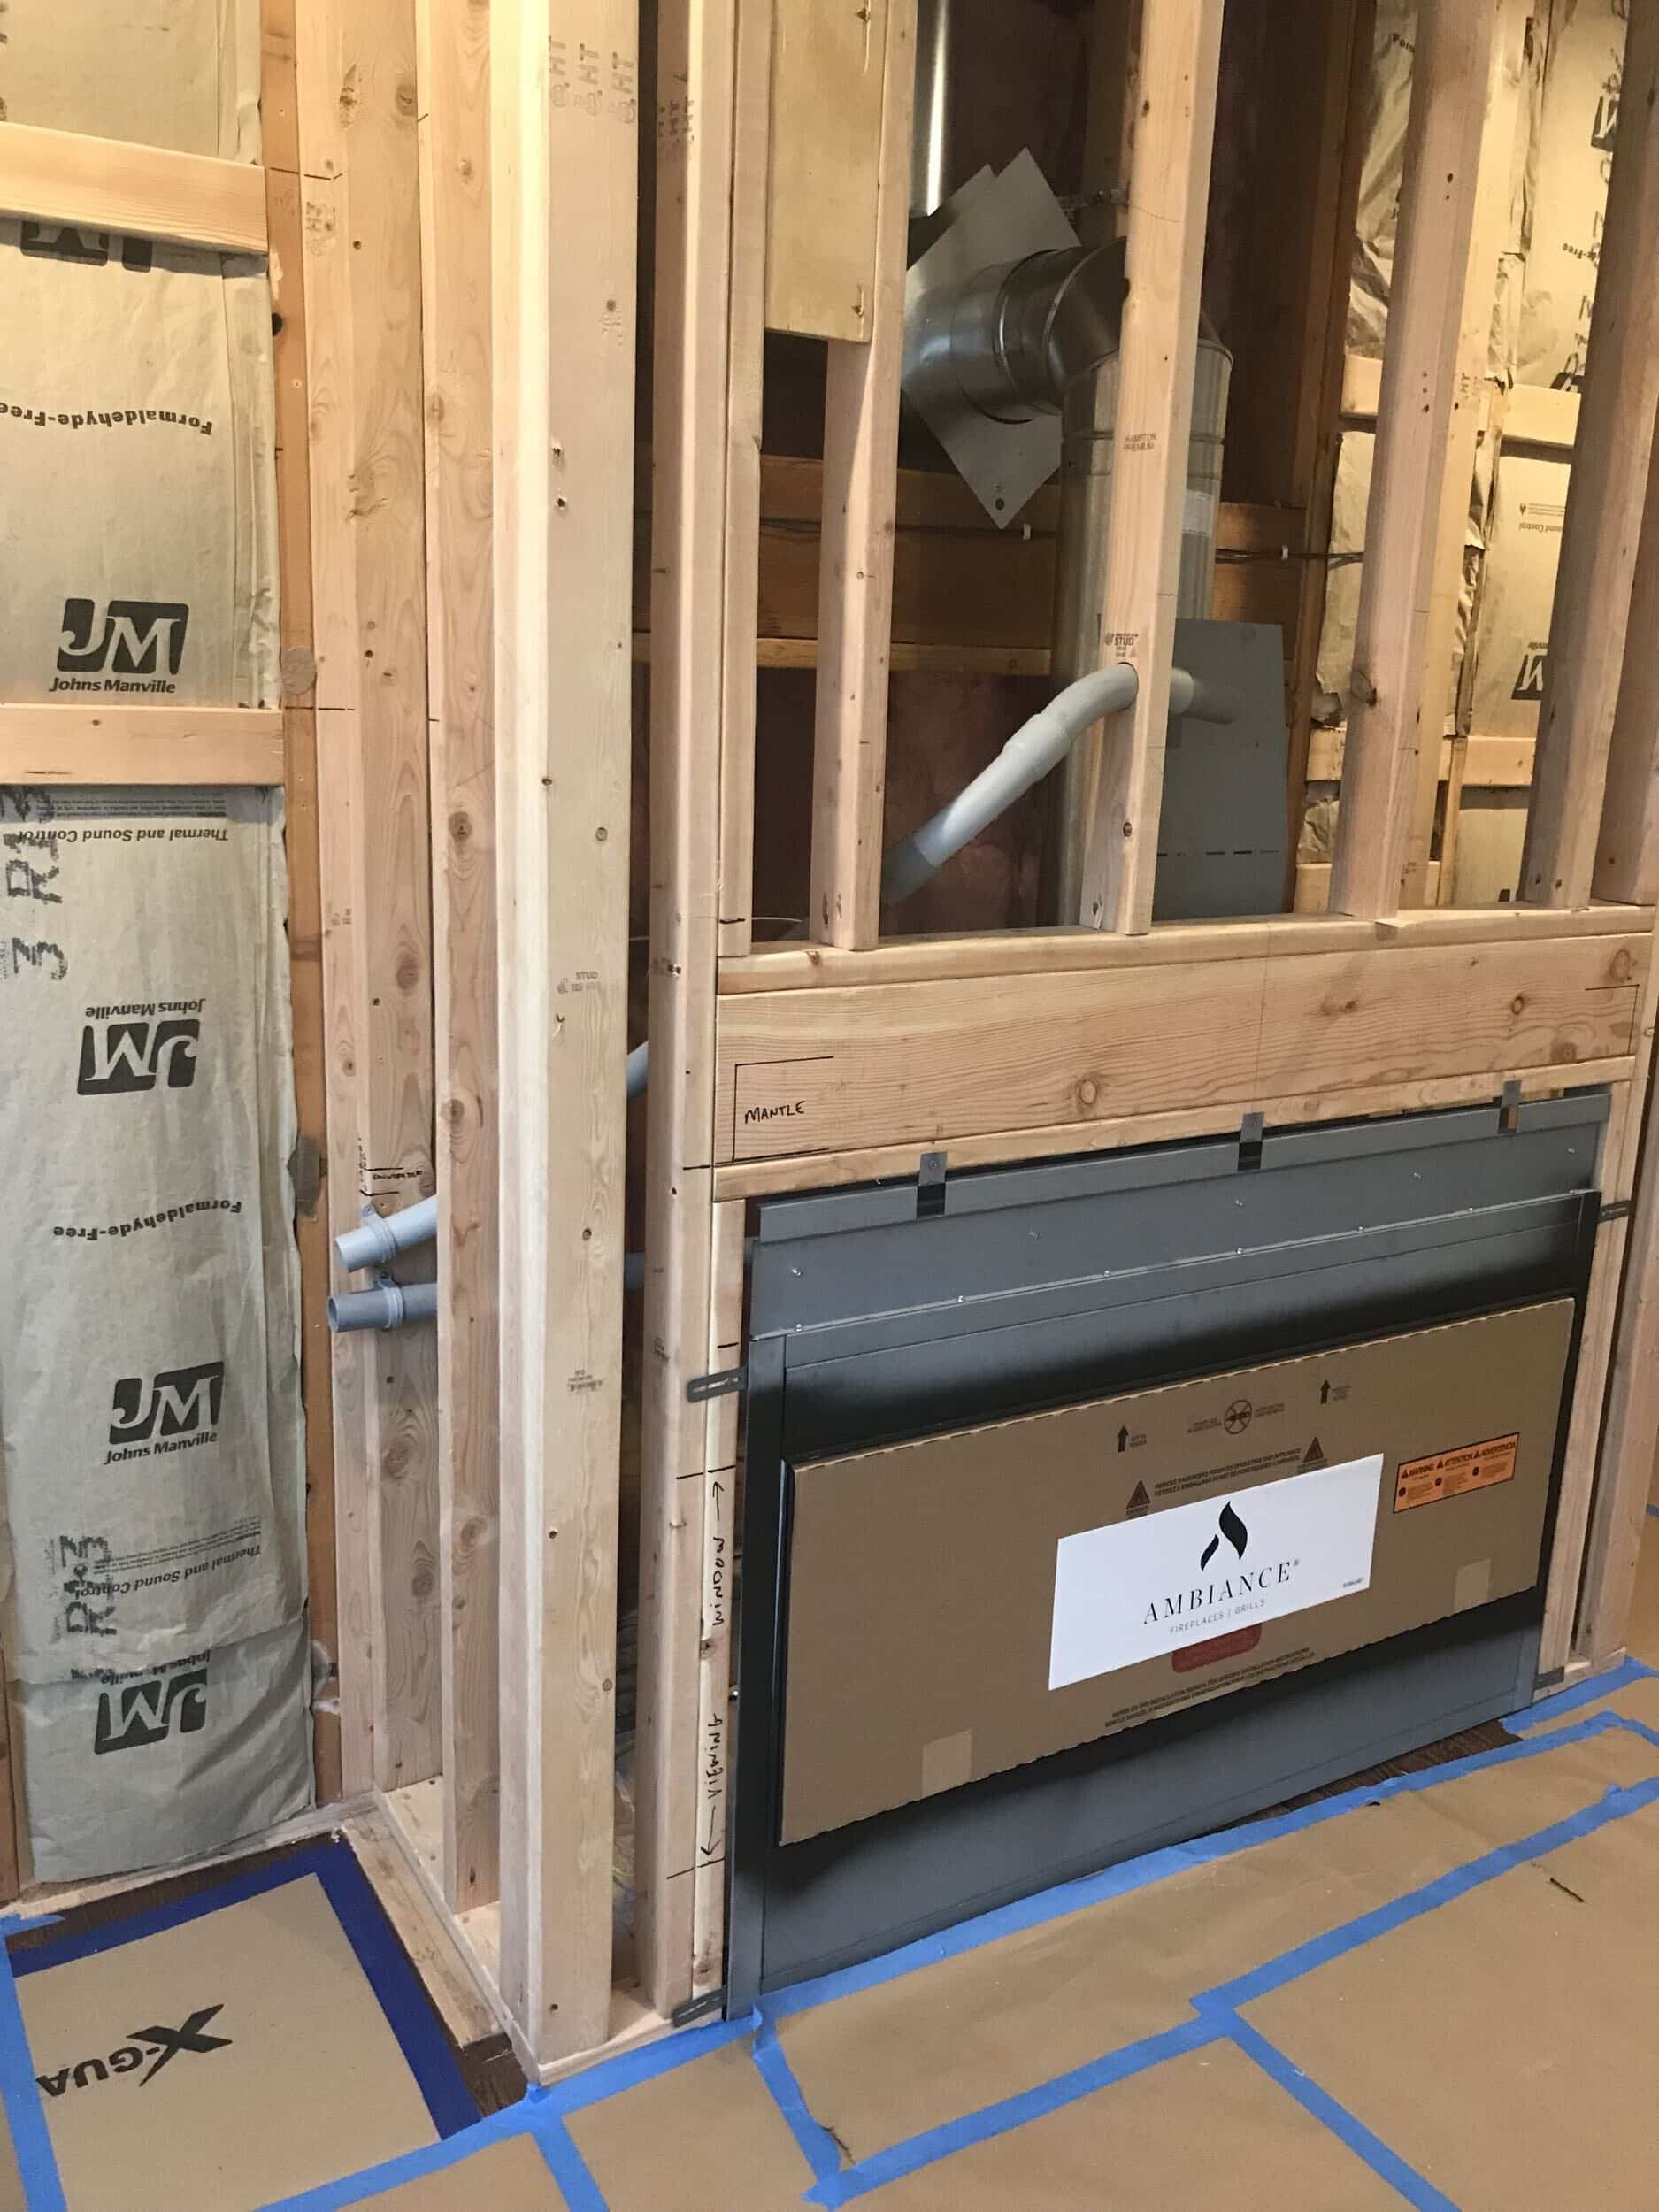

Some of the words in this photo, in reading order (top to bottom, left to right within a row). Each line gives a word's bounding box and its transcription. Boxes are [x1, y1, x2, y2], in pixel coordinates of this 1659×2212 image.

[57, 598, 189, 675] JM
[1115, 636, 1134, 646] STUD
[49, 677, 101, 692] Johns
[104, 679, 176, 694] Manville
[82, 829, 133, 843] Sound
[138, 829, 165, 840] and
[169, 828, 228, 841] Thermal
[85, 1004, 156, 1020] Manville
[158, 999, 205, 1013] Johns
[77, 1018, 201, 1096] JM
[745, 1100, 806, 1125] MANTLE
[53, 1199, 242, 1241] Formaldehyde-Free
[109, 1361, 225, 1445] JM
[104, 1447, 150, 1465] Johns
[153, 1432, 218, 1455] Manville
[211, 1544, 262, 1571] Thermal
[134, 1571, 180, 1591] Sound
[185, 1563, 209, 1580] and
[710, 1537, 725, 1627] WINDOW
[1170, 1611, 1224, 1635] FIREPLACES
[1235, 1600, 1265, 1615] GRILLS
[95, 1668, 208, 1755] JM
[706, 1712, 724, 1800] VIEWING
[35, 2003, 233, 2097] X-GUA
